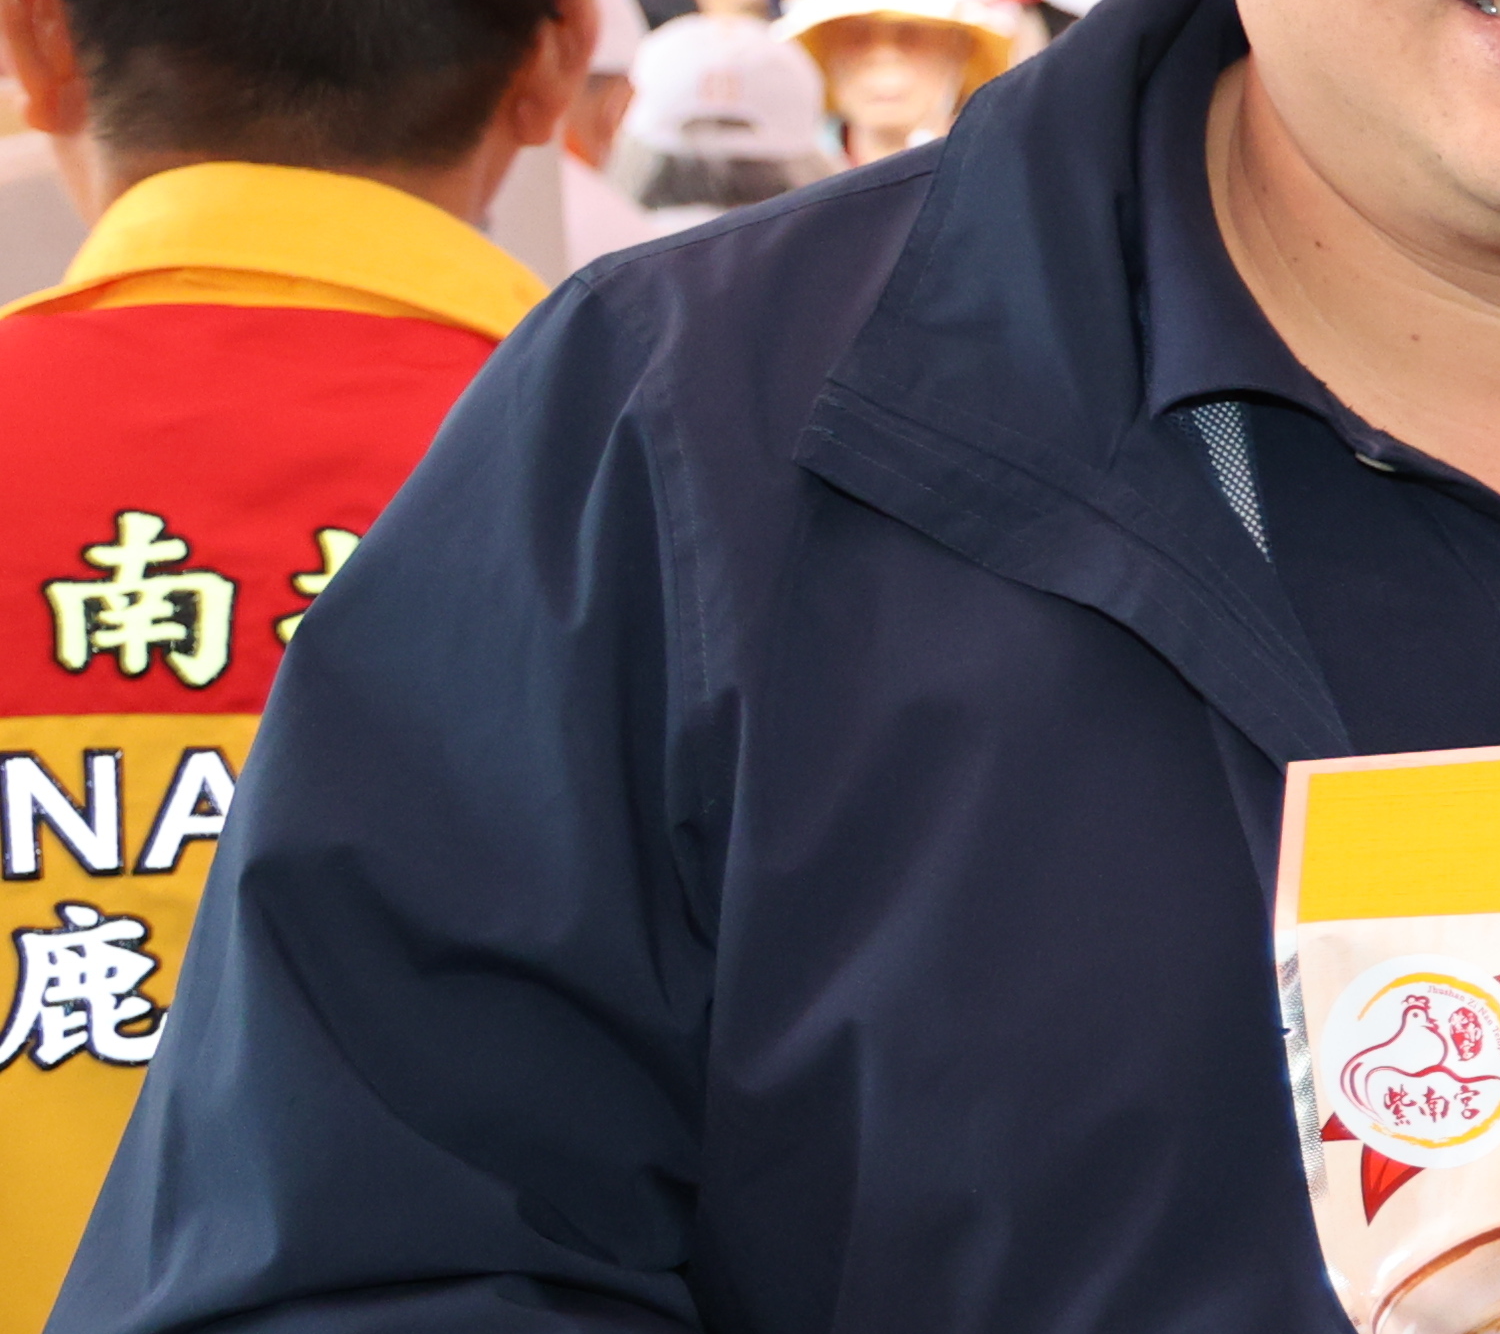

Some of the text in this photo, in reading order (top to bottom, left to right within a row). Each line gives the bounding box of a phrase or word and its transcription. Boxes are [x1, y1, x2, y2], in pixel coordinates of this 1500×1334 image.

[0, 903, 170, 1068] 鹿
[1383, 1084, 1480, 1126] 紫南宮
